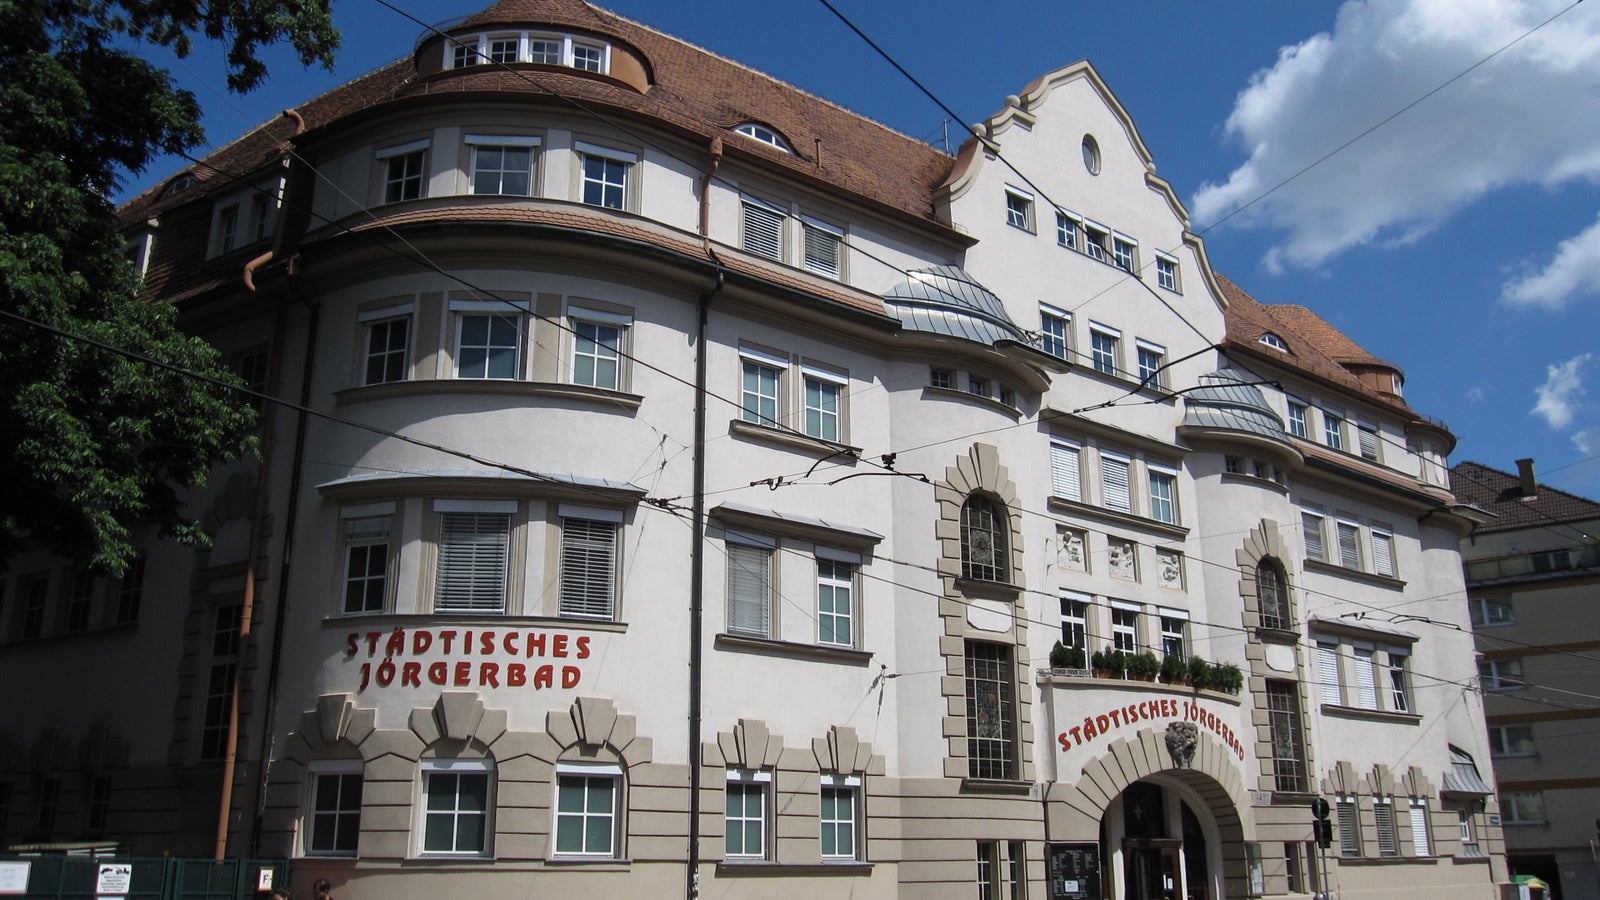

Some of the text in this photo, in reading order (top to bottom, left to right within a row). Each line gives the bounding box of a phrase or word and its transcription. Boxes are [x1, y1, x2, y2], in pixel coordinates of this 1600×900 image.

[346, 626, 591, 659] STÄDTISCHES
[359, 658, 581, 691] JÖRGERBAD
[1058, 699, 1245, 762] STÄDTISCHES JÖRGERBAD
